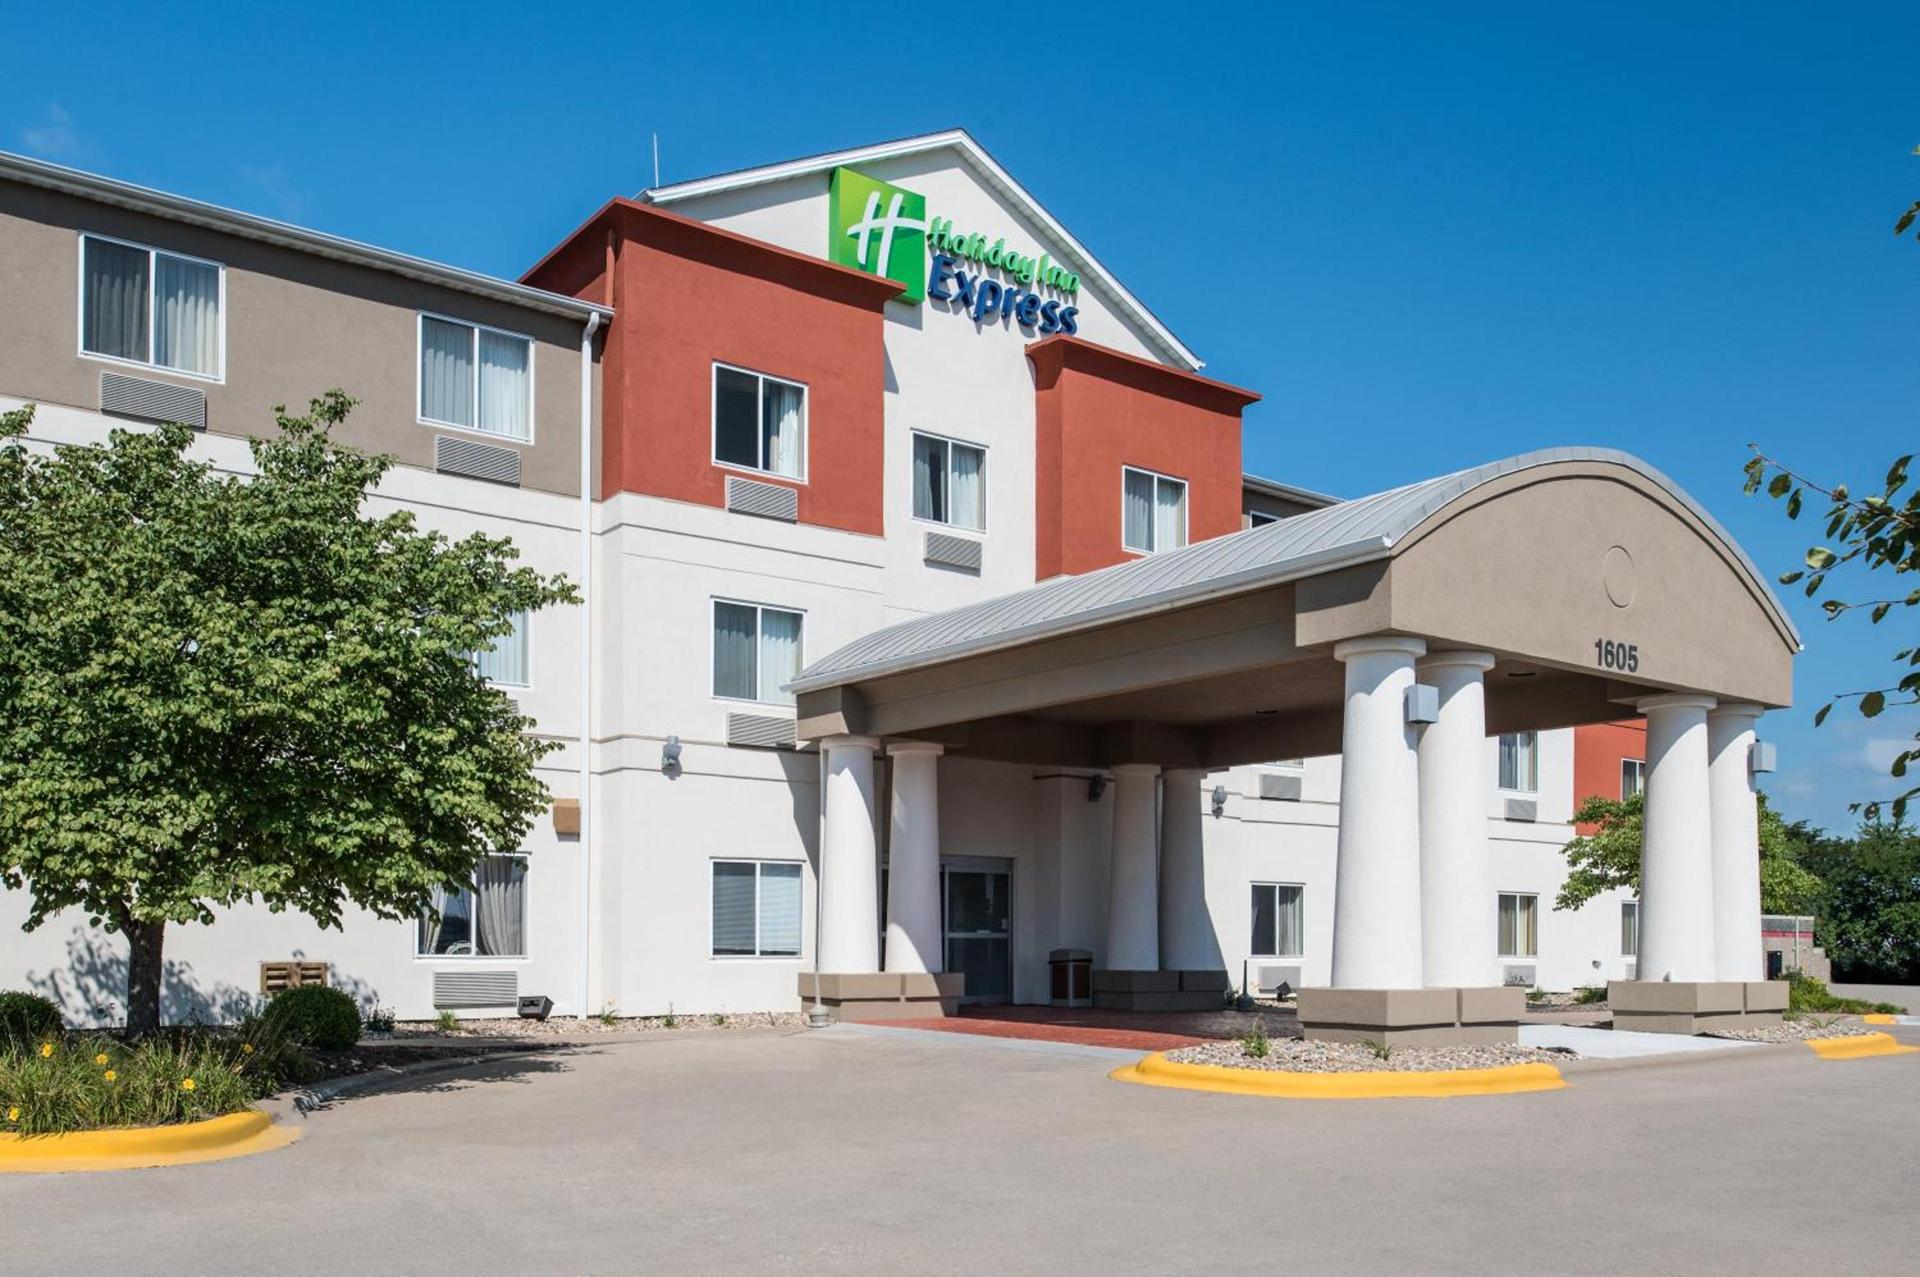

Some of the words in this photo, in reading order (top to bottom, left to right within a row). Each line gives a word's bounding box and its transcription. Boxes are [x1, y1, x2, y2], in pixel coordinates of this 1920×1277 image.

[927, 216, 1036, 286] Holiday
[1036, 252, 1080, 294] Inn
[928, 254, 1079, 335] Express
[1595, 638, 1639, 673] 1605
